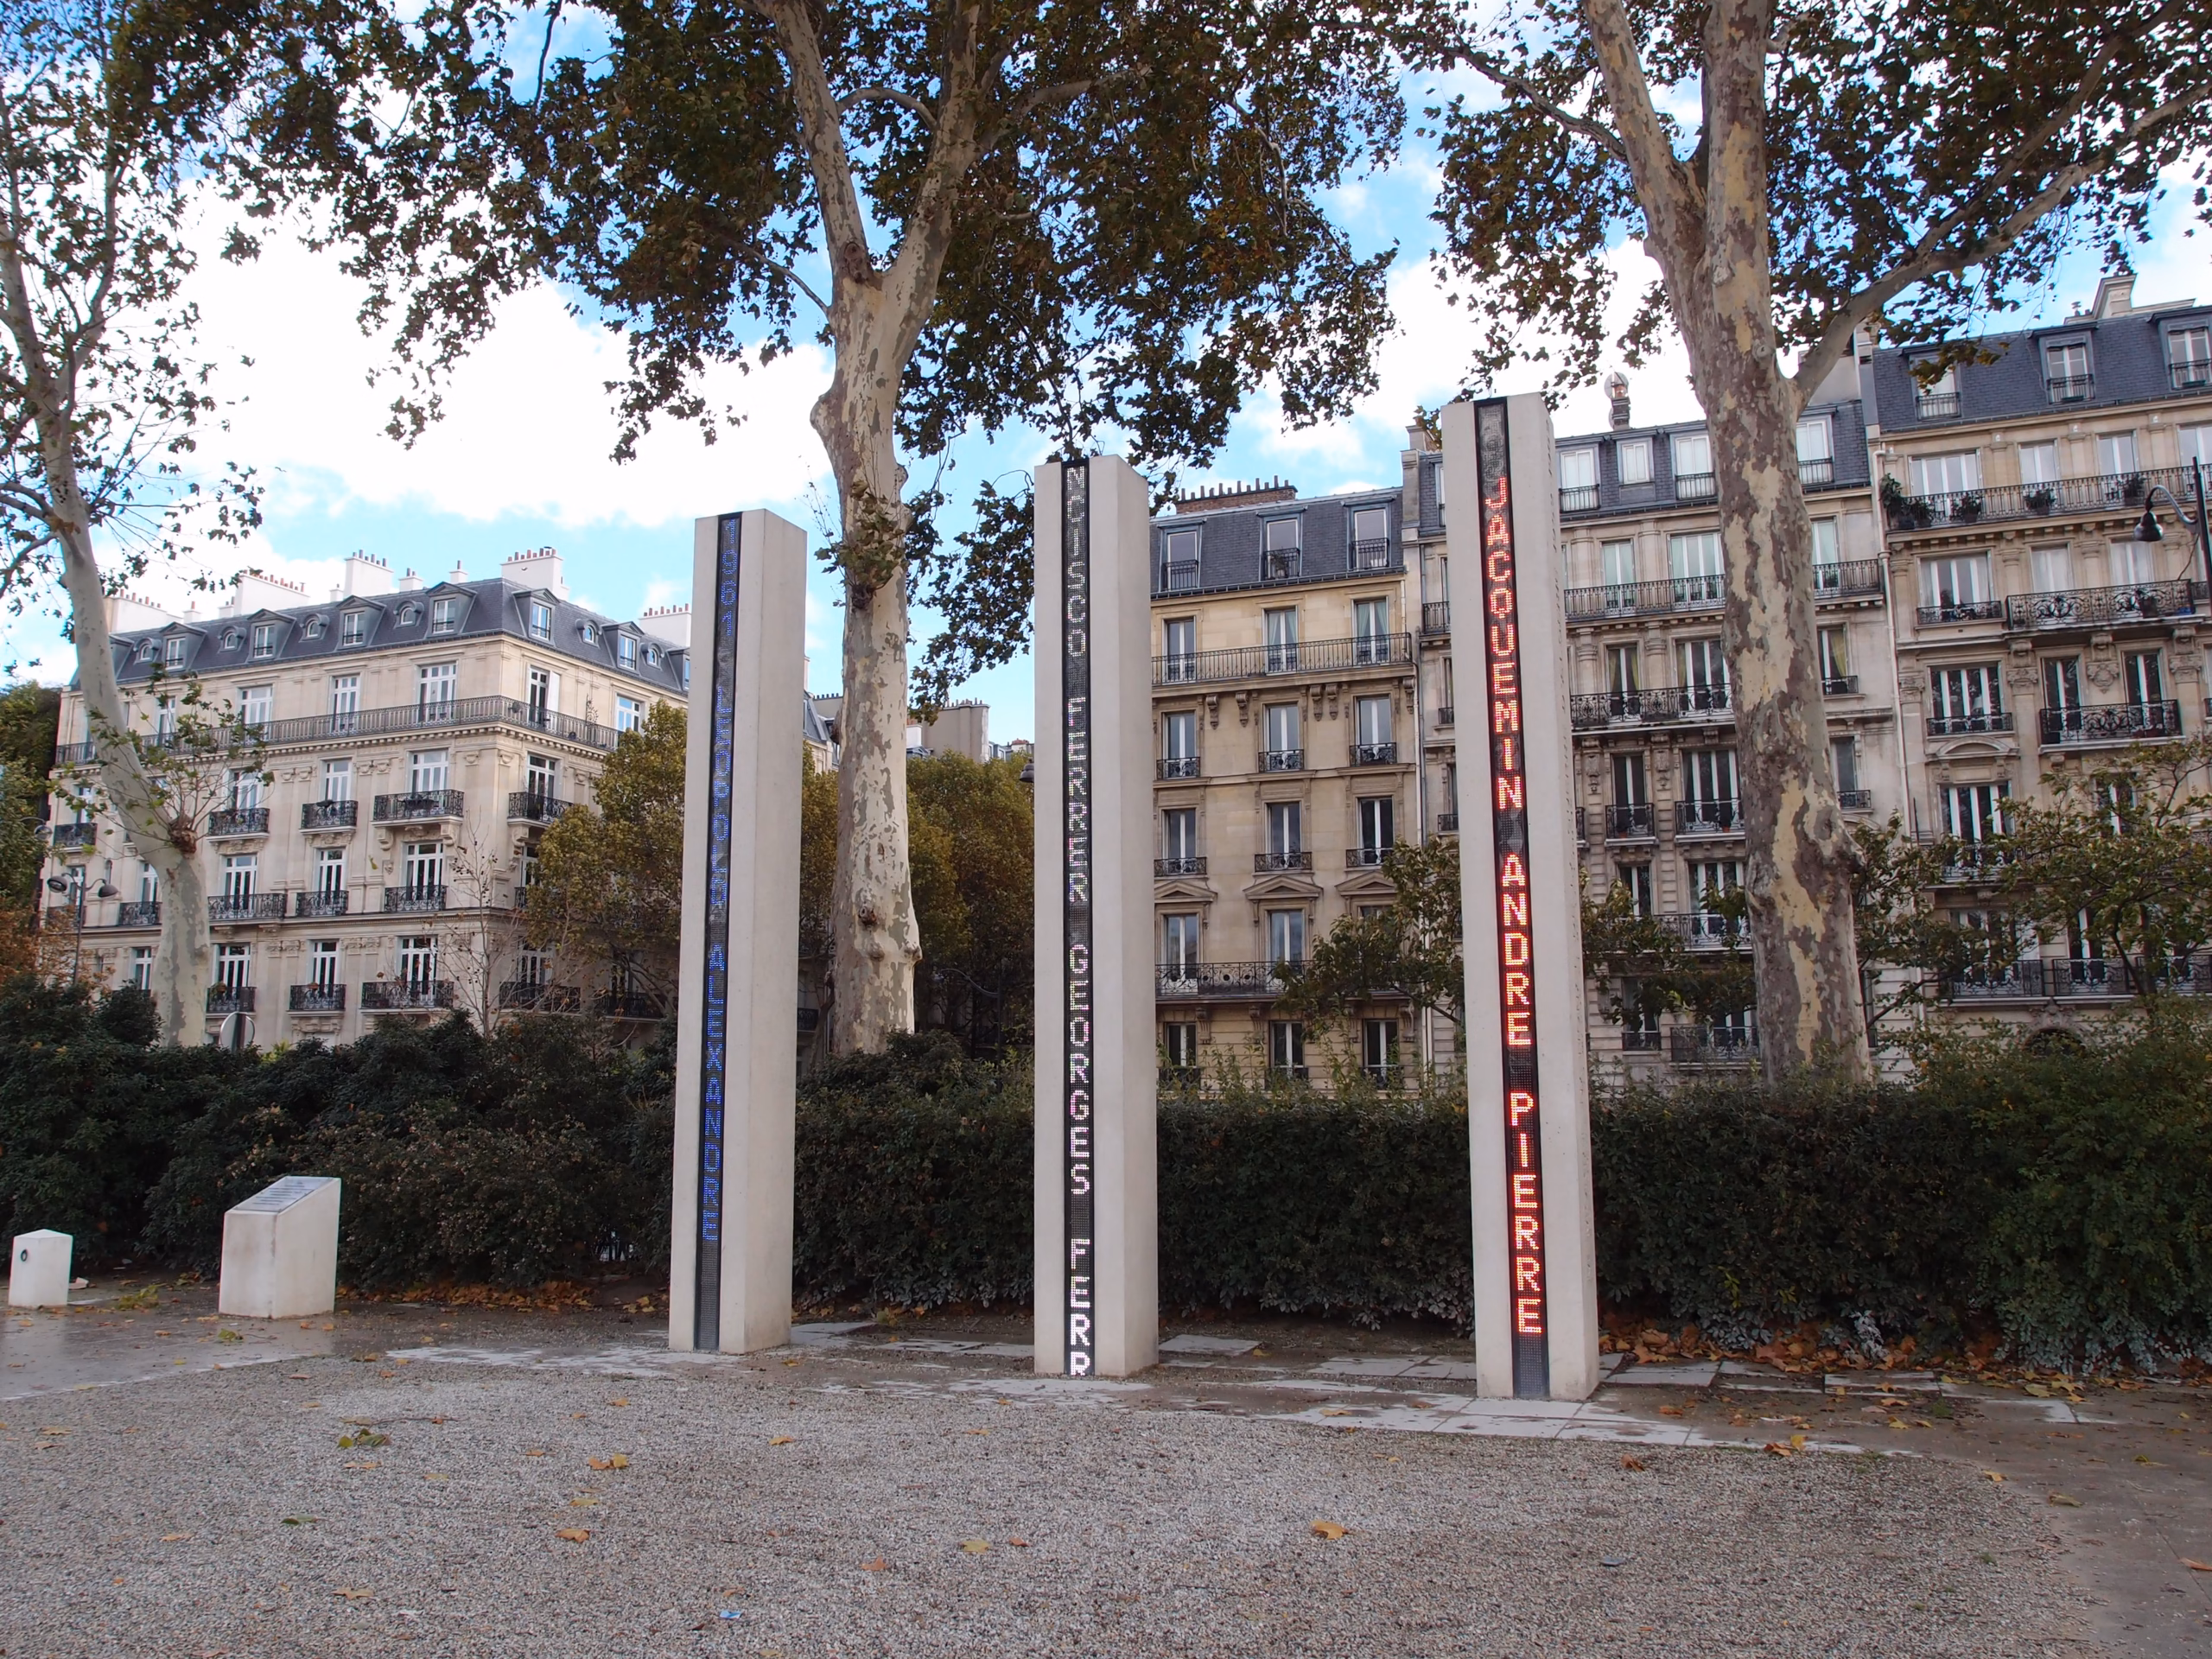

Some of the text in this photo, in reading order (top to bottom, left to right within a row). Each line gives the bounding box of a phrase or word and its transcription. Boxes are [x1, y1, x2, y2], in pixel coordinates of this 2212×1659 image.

[1067, 466, 1086, 658] NCISCO
[702, 518, 737, 1241] 1961 LEOPOLD ALEXANDRE
[1068, 697, 1088, 901] FERRER
[1484, 477, 1542, 1334] JACQUEMIN ANDRE PIERRE
[1070, 944, 1090, 1194] GEORGES
